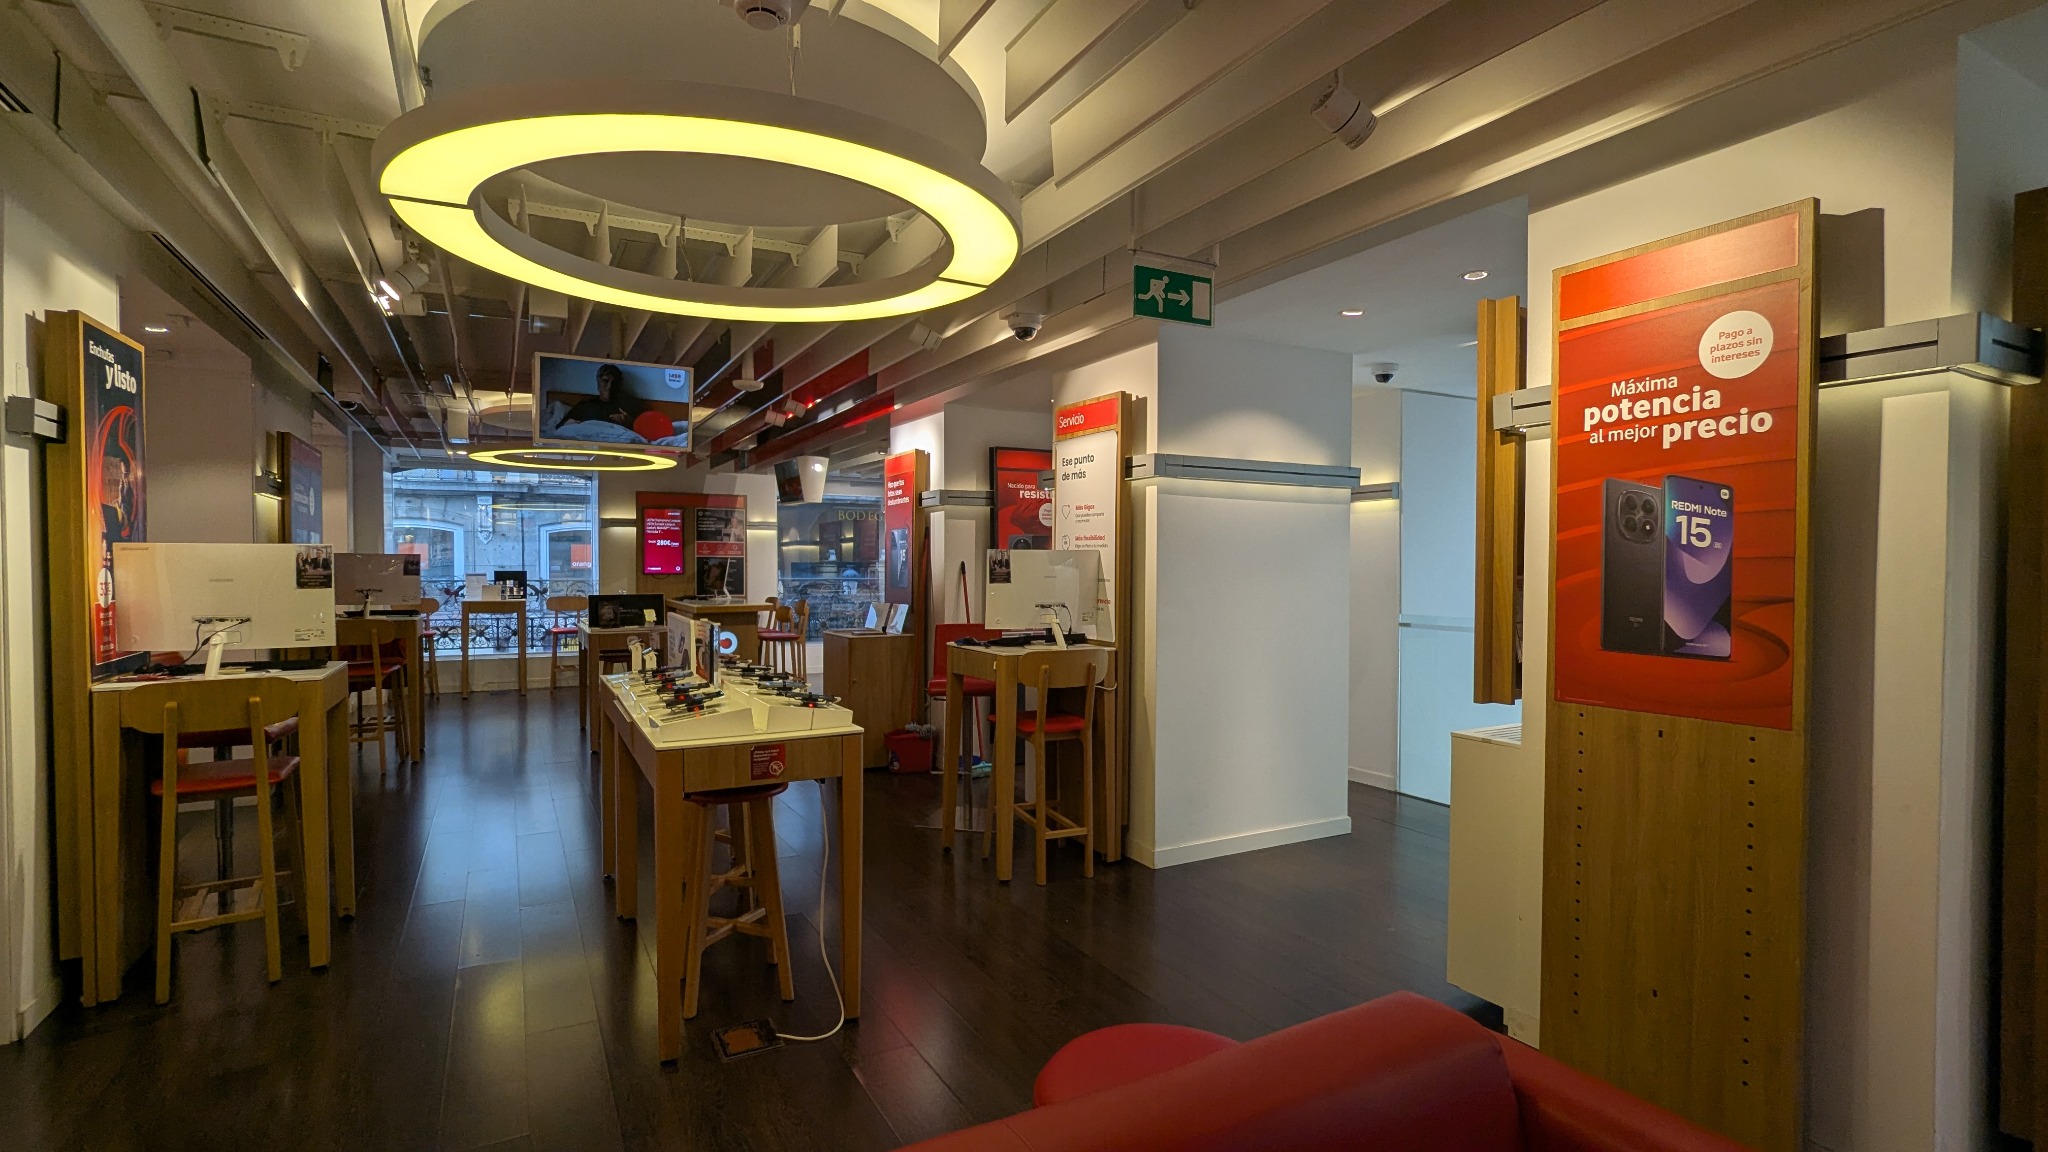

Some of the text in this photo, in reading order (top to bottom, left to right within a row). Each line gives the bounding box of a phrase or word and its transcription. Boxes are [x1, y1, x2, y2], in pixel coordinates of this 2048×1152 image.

[1718, 329, 1744, 340] Pago
[88, 340, 115, 364] Enchufas
[1709, 336, 1763, 355] plazos sin
[1711, 349, 1761, 364] intereses
[105, 363, 137, 394] y listo
[1611, 376, 1678, 398] Máxima
[1583, 385, 1721, 432] potencia
[1059, 412, 1085, 429] Servicio
[1589, 407, 1773, 450] al mejor precio
[1061, 453, 1095, 468] Ese punto
[1061, 468, 1087, 481] de más
[838, 510, 883, 521] BODEG
[1671, 500, 1728, 518] REDMI Note
[1675, 515, 1712, 548] 15
